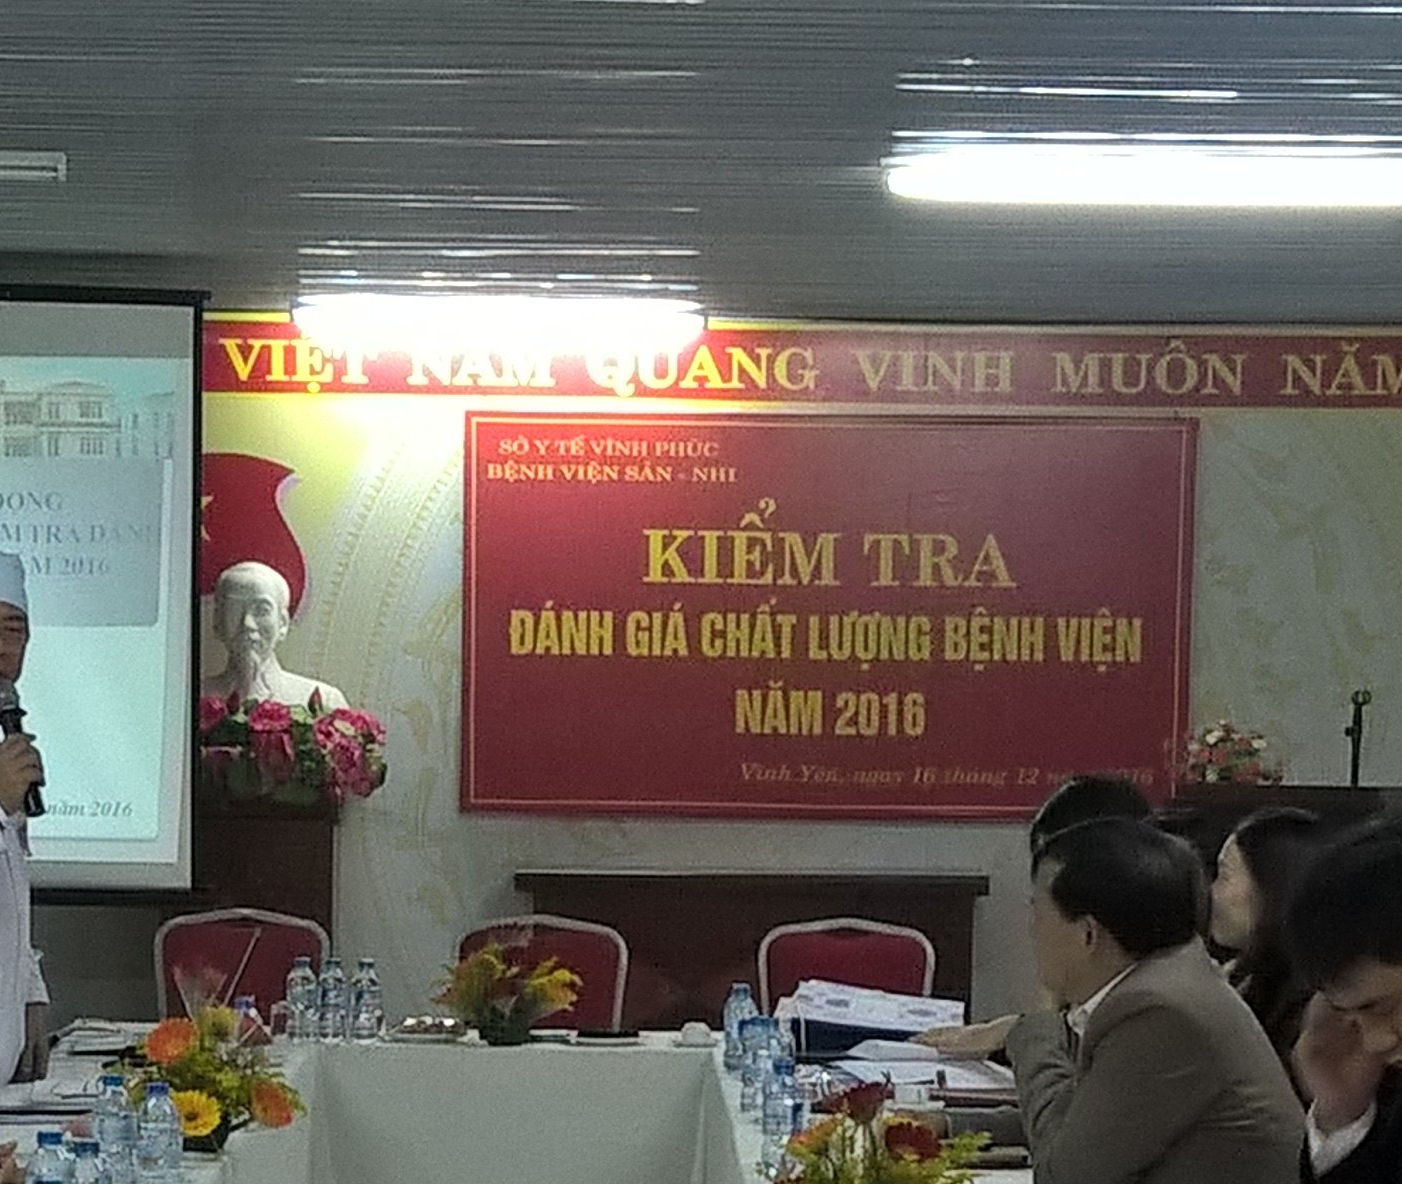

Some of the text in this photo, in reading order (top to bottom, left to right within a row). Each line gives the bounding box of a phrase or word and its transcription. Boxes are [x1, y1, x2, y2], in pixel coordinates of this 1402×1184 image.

[406, 341, 556, 388] NAM
[586, 345, 822, 398] QUANG
[850, 349, 1014, 394] VINH
[1052, 339, 1245, 397] MUÔN
[534, 440, 550, 456] Y
[554, 434, 585, 456] TẾ
[487, 460, 554, 483] BỆNH
[559, 461, 620, 484] VIỆN
[692, 466, 738, 483] NHI
[642, 497, 1017, 587] KIỂM TRA
[508, 597, 1142, 672] ĐÁNH GIÁ CHẤT LƯỢNG BỆNH VIỆN
[735, 681, 926, 736] NĂM 2016
[913, 766, 937, 784] 16
[1017, 767, 1041, 784] 12
[91, 801, 134, 818] 2016
